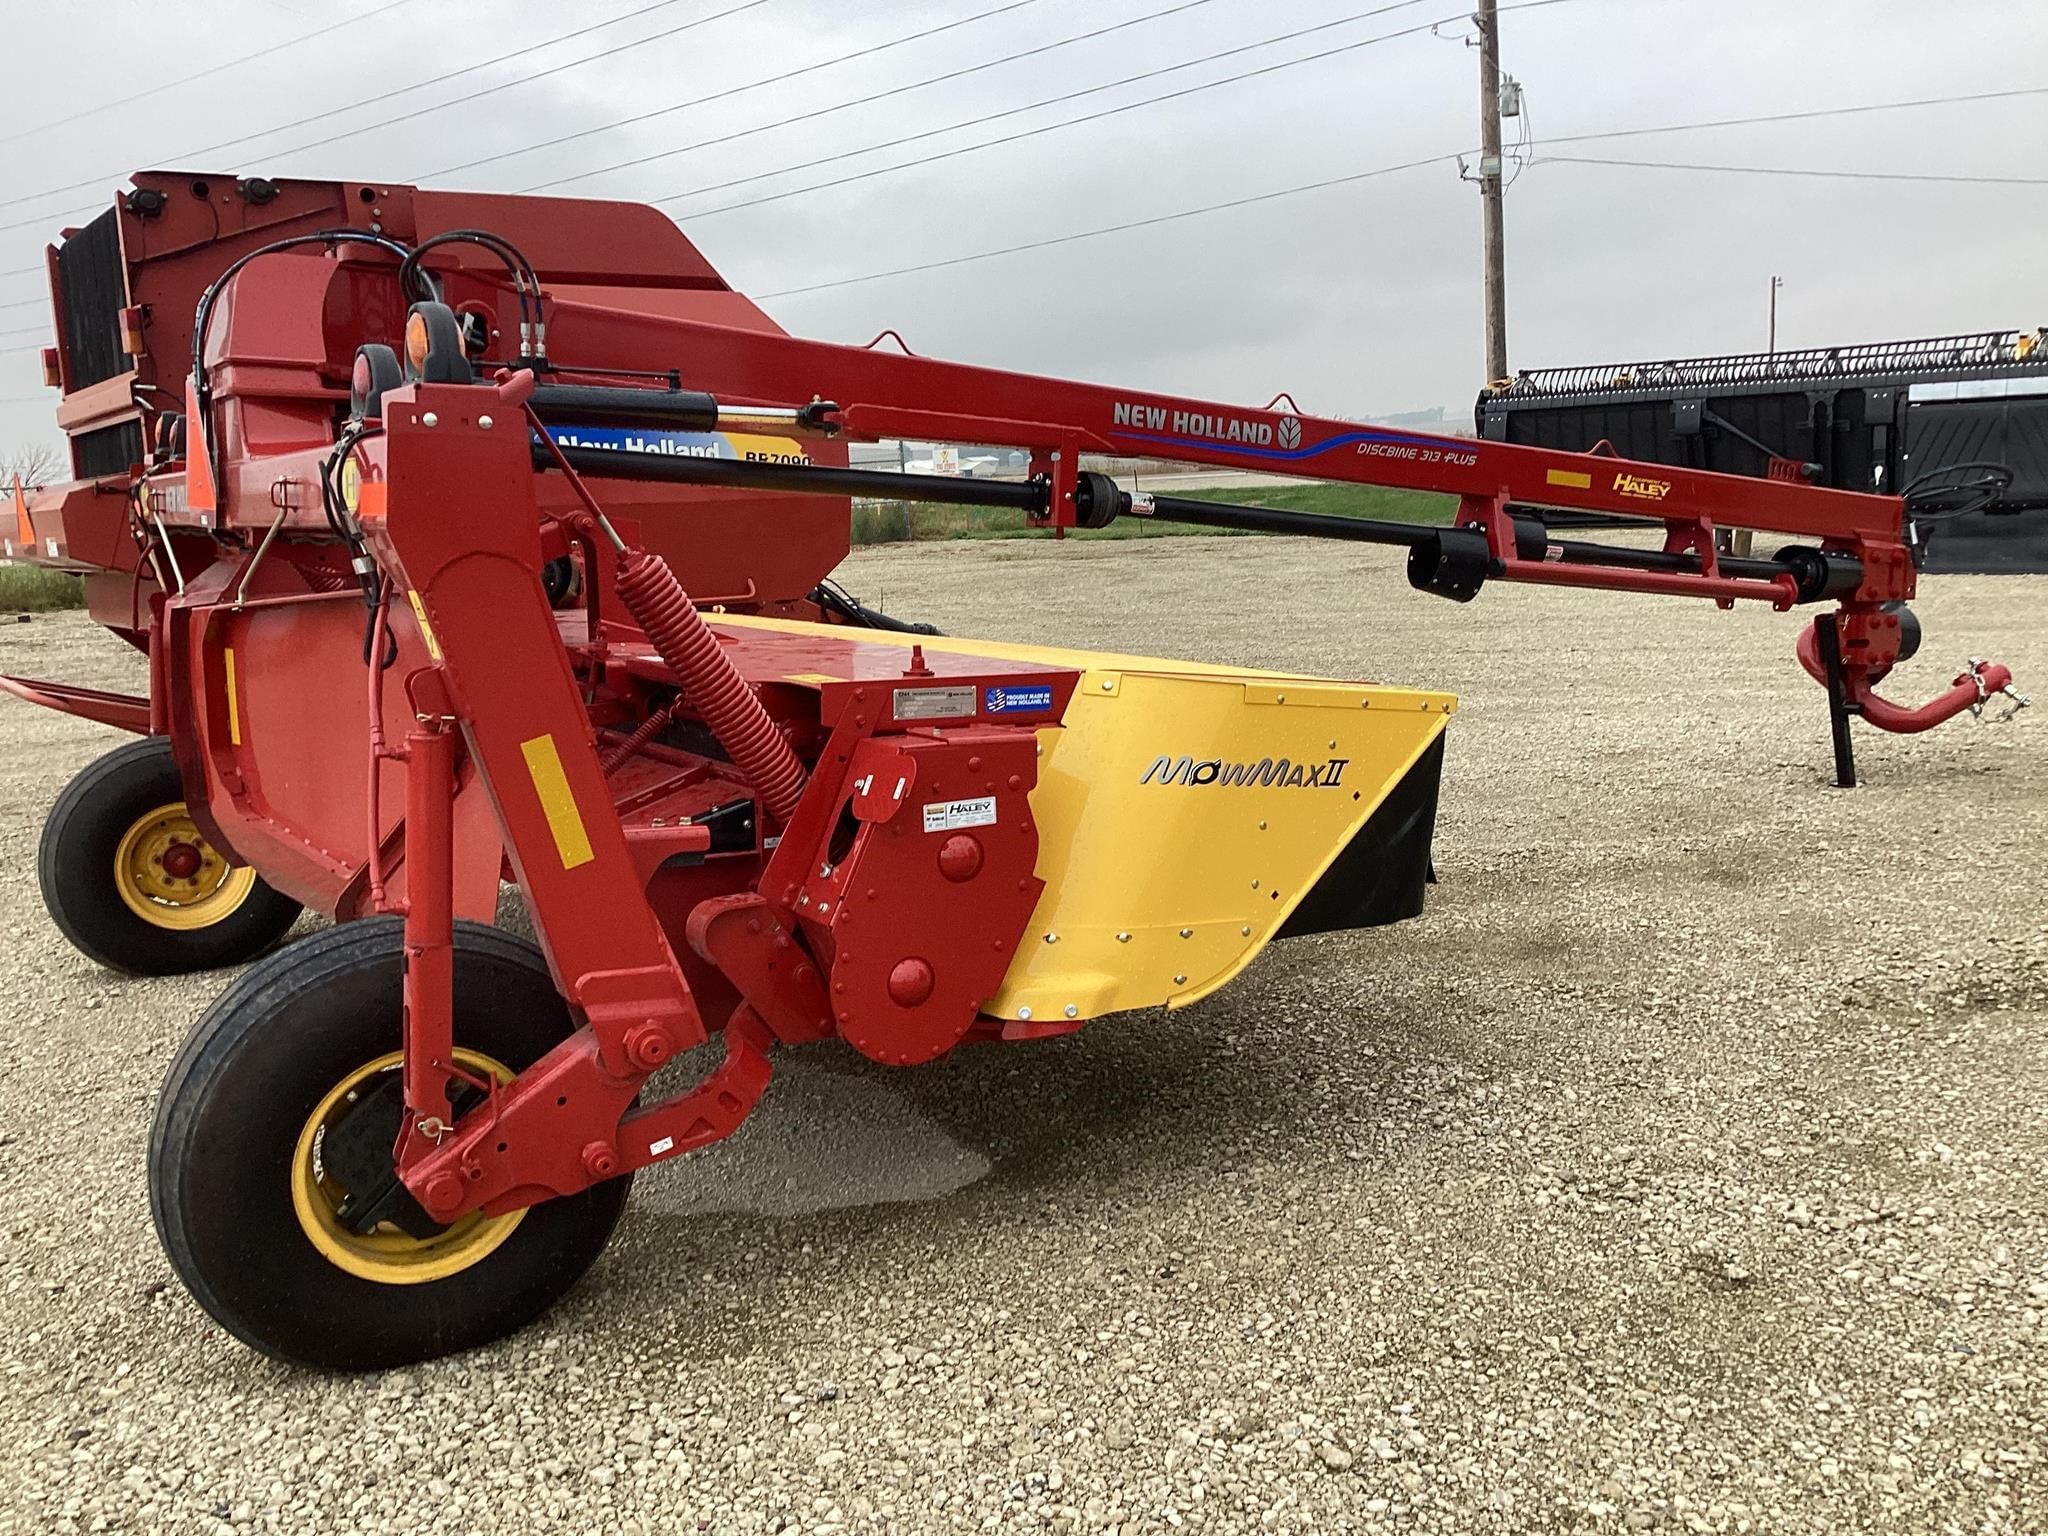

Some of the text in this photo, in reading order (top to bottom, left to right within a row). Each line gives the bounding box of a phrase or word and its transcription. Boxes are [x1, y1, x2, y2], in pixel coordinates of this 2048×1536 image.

[1113, 402, 1273, 445] NEW HOLLAND
[1357, 443, 1418, 459] DISCBINE
[1419, 450, 1441, 462] 313
[1612, 473, 1671, 497] HALEY
